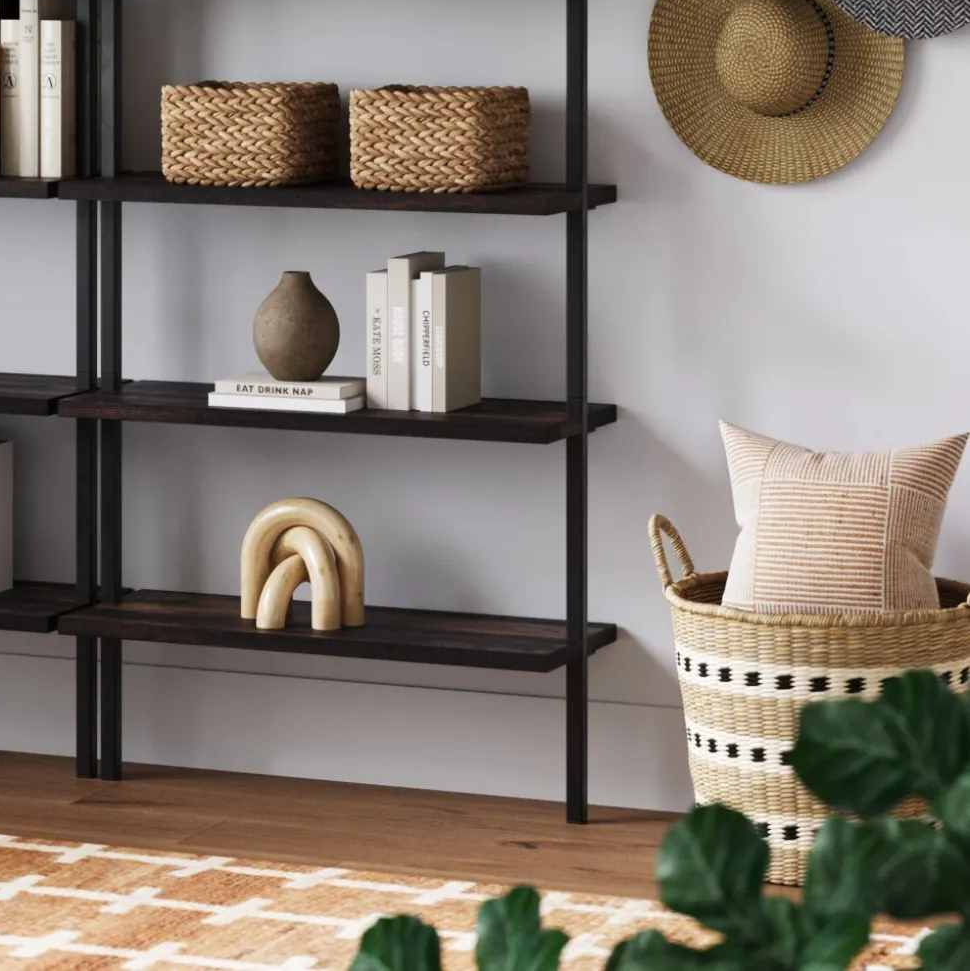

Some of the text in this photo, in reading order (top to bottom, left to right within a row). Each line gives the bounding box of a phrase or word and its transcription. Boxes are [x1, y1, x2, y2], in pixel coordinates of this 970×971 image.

[372, 316, 381, 376] KATE MOSS
[392, 338, 405, 364] BOOK
[422, 310, 430, 367] CHIPPERFIELD
[236, 384, 314, 396] EAT DRINK NAP
